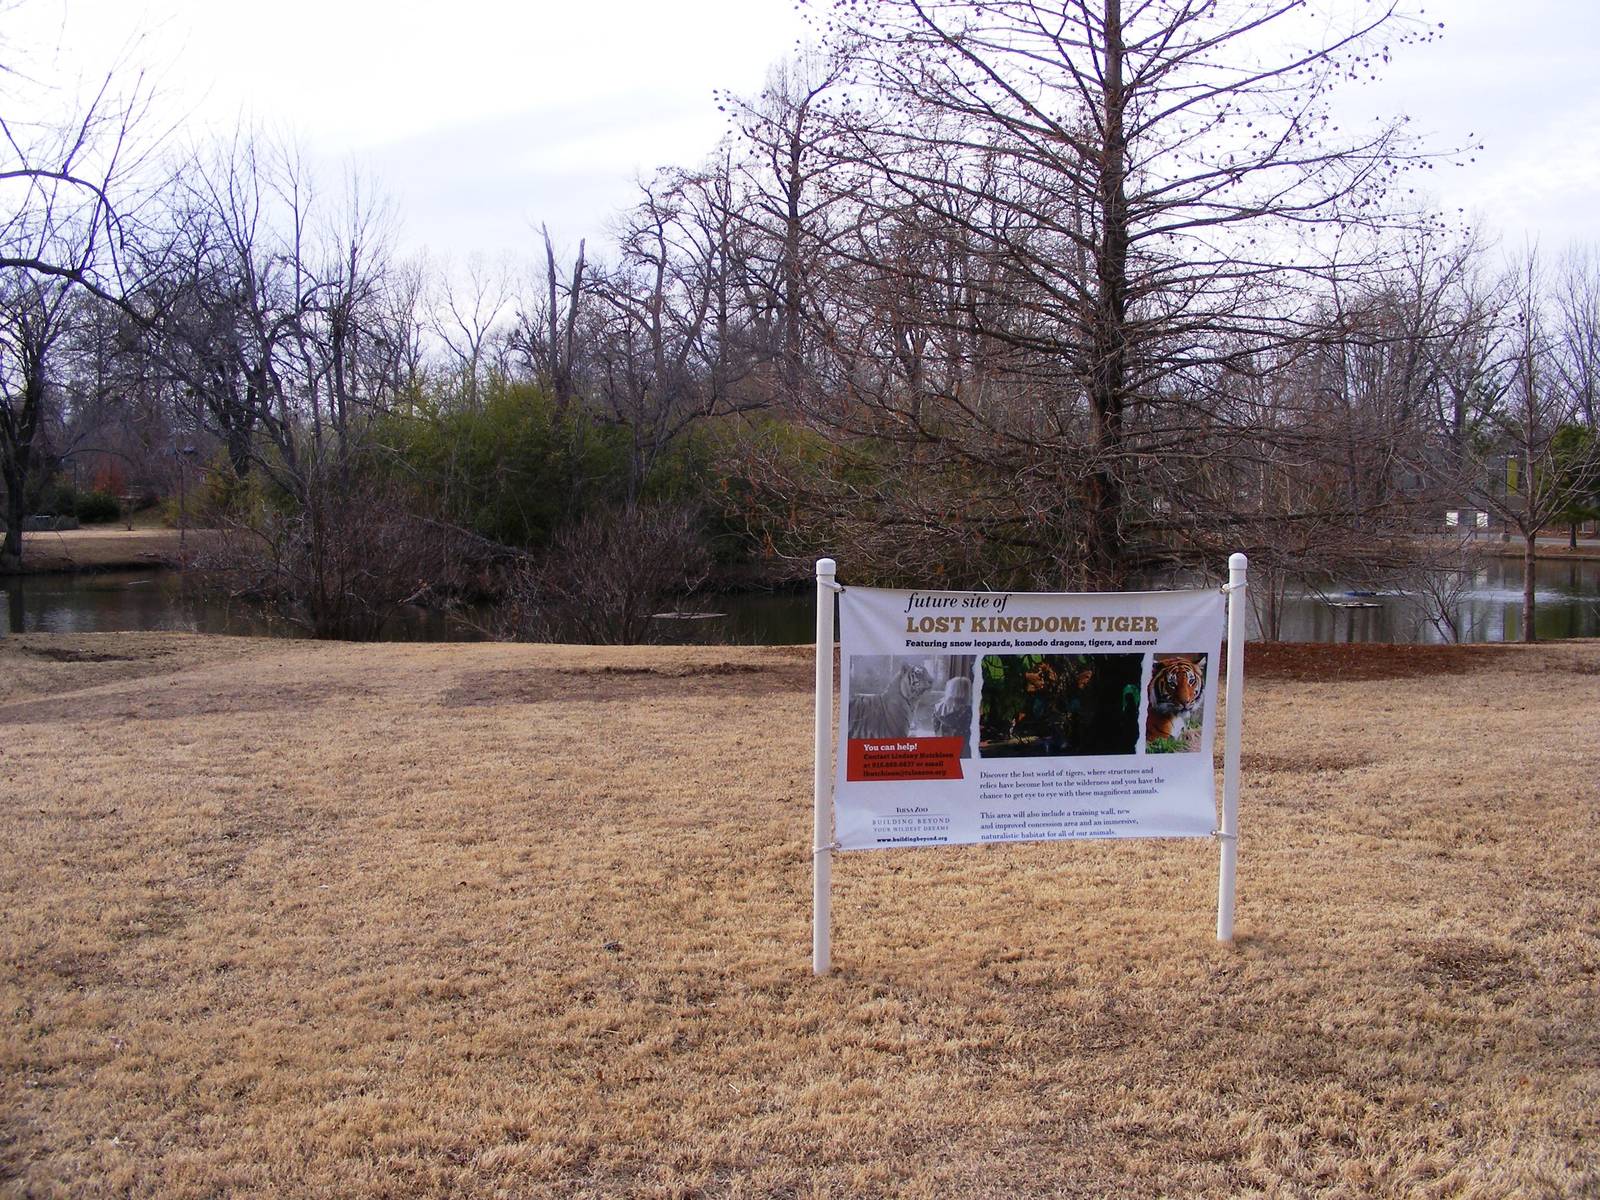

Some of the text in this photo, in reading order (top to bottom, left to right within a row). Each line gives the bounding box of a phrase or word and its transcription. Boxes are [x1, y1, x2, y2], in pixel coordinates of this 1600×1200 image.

[904, 593, 1012, 613] future site of
[906, 616, 1159, 633] LOST KINGDOM: TIGER
[905, 639, 948, 649] Featuring
[974, 639, 1013, 648] leopards,
[1015, 639, 1048, 647] komodo
[1050, 639, 1087, 648] dragons,
[1089, 639, 1115, 648] tigers,
[1116, 638, 1132, 646] and
[1134, 638, 1158, 646] more!
[897, 743, 918, 752] help!
[980, 771, 1008, 779] Discover
[1010, 770, 1021, 778] the
[1056, 769, 1063, 777] of
[1066, 769, 1085, 777] tigers,
[1013, 792, 1023, 800] get
[1093, 788, 1131, 797] magnificent
[1072, 809, 1099, 817] training
[995, 821, 1026, 831] improved
[981, 832, 1020, 840] naturalistic
